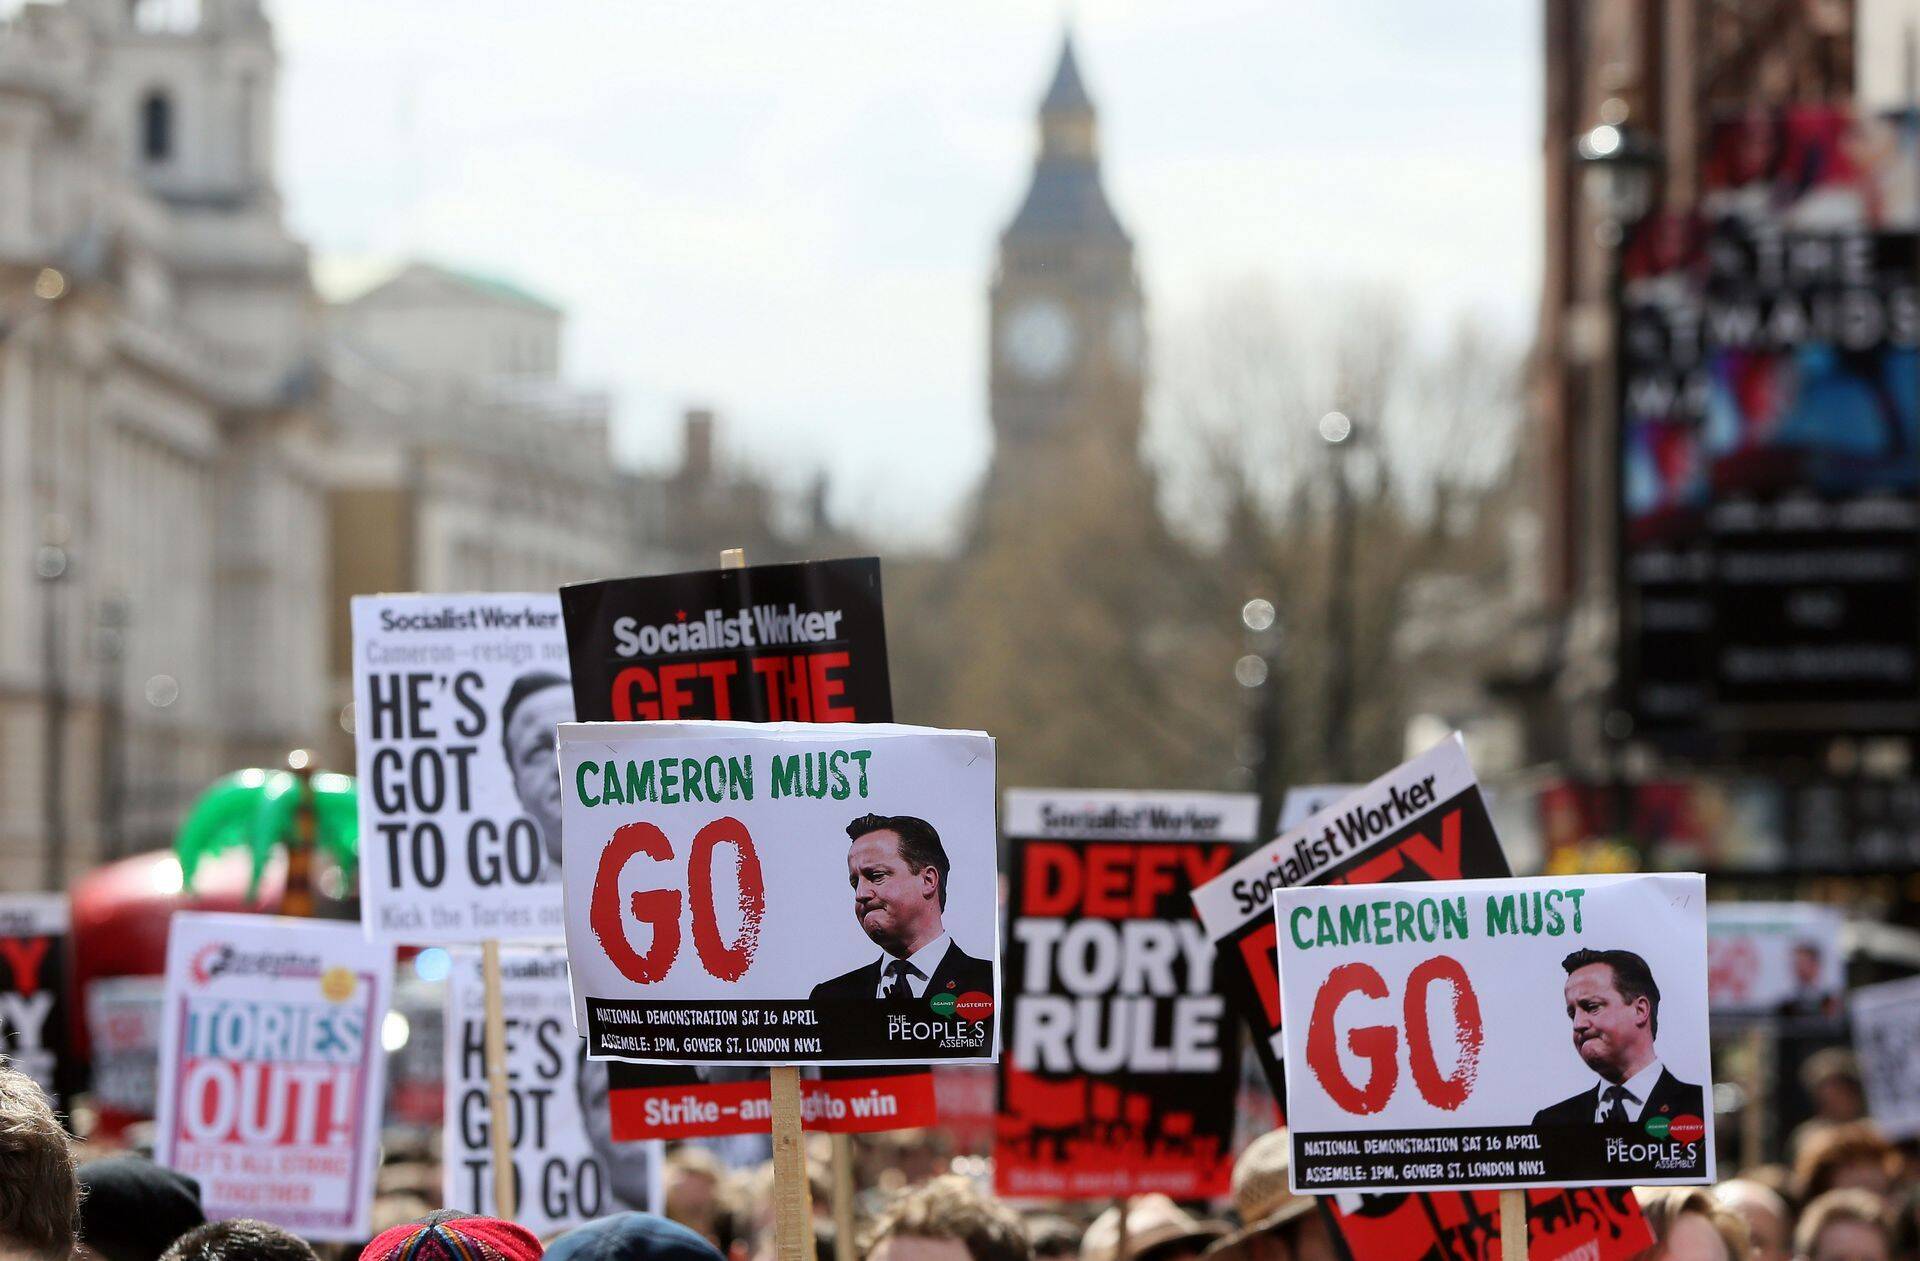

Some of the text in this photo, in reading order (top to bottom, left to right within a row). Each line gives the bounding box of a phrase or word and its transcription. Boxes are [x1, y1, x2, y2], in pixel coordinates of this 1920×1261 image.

[380, 605, 560, 631] Socialist Worker
[613, 603, 843, 657] Socialist Worker
[369, 671, 487, 739] HE'S
[611, 651, 857, 723] GET THE
[372, 746, 478, 815] GOT
[576, 750, 872, 807] CAMERON MUST
[1041, 803, 1222, 831] Socialist Worker
[1232, 827, 1344, 916] Socialist
[1334, 774, 1438, 849] Worker
[376, 818, 541, 889] TO GO
[590, 816, 765, 985] GO
[1290, 889, 1586, 950] CAMERON MUST
[1014, 917, 1218, 997] TORY
[188, 1003, 363, 1060] TORIES
[596, 1007, 819, 1027] NATIONAL DEMONSTRATION SAT 16 APRIL
[601, 1033, 651, 1051] ASSEMBLE:
[654, 1037, 680, 1053] 1PM,
[683, 1037, 723, 1053] GOWER
[746, 1038, 790, 1053] LONDON
[794, 1038, 823, 1053] NW1
[887, 1014, 907, 1024] THE
[939, 1038, 985, 1049] ASSEMBLY
[1012, 994, 1226, 1074] RULE
[1306, 955, 1484, 1115] GO
[183, 1062, 349, 1147] OUT!
[850, 1089, 898, 1118] win
[1303, 1134, 1542, 1156] NATIONAL DEMONSTRATION SAT 16 APRIL
[1605, 1137, 1624, 1147] THE
[1654, 1159, 1697, 1169] ASSEMBLY
[541, 1157, 602, 1220] GO
[1305, 1165, 1367, 1182] ASSEMBLE:
[1370, 1164, 1399, 1181] 1PM,
[1402, 1162, 1444, 1180] GOWER
[1467, 1161, 1516, 1177] LONDON
[1518, 1160, 1546, 1176] NW1
